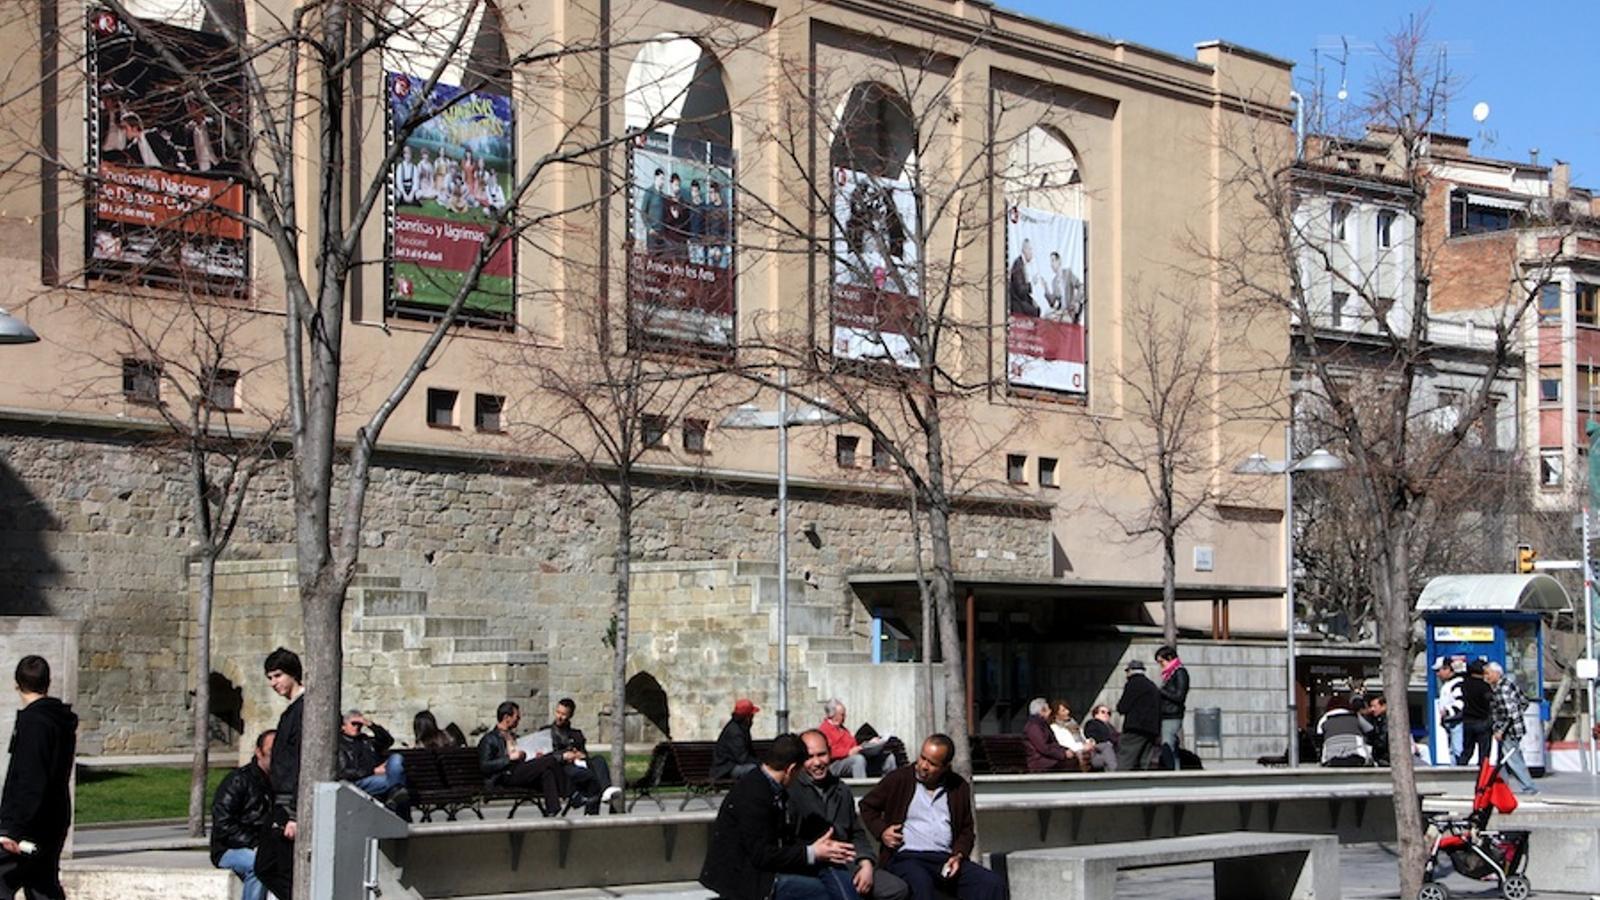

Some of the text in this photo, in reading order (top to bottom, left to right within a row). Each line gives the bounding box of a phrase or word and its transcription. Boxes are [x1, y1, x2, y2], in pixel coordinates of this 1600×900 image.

[161, 177, 210, 199] Nacional
[395, 215, 435, 235] Sonrisas
[435, 225, 443, 239] y
